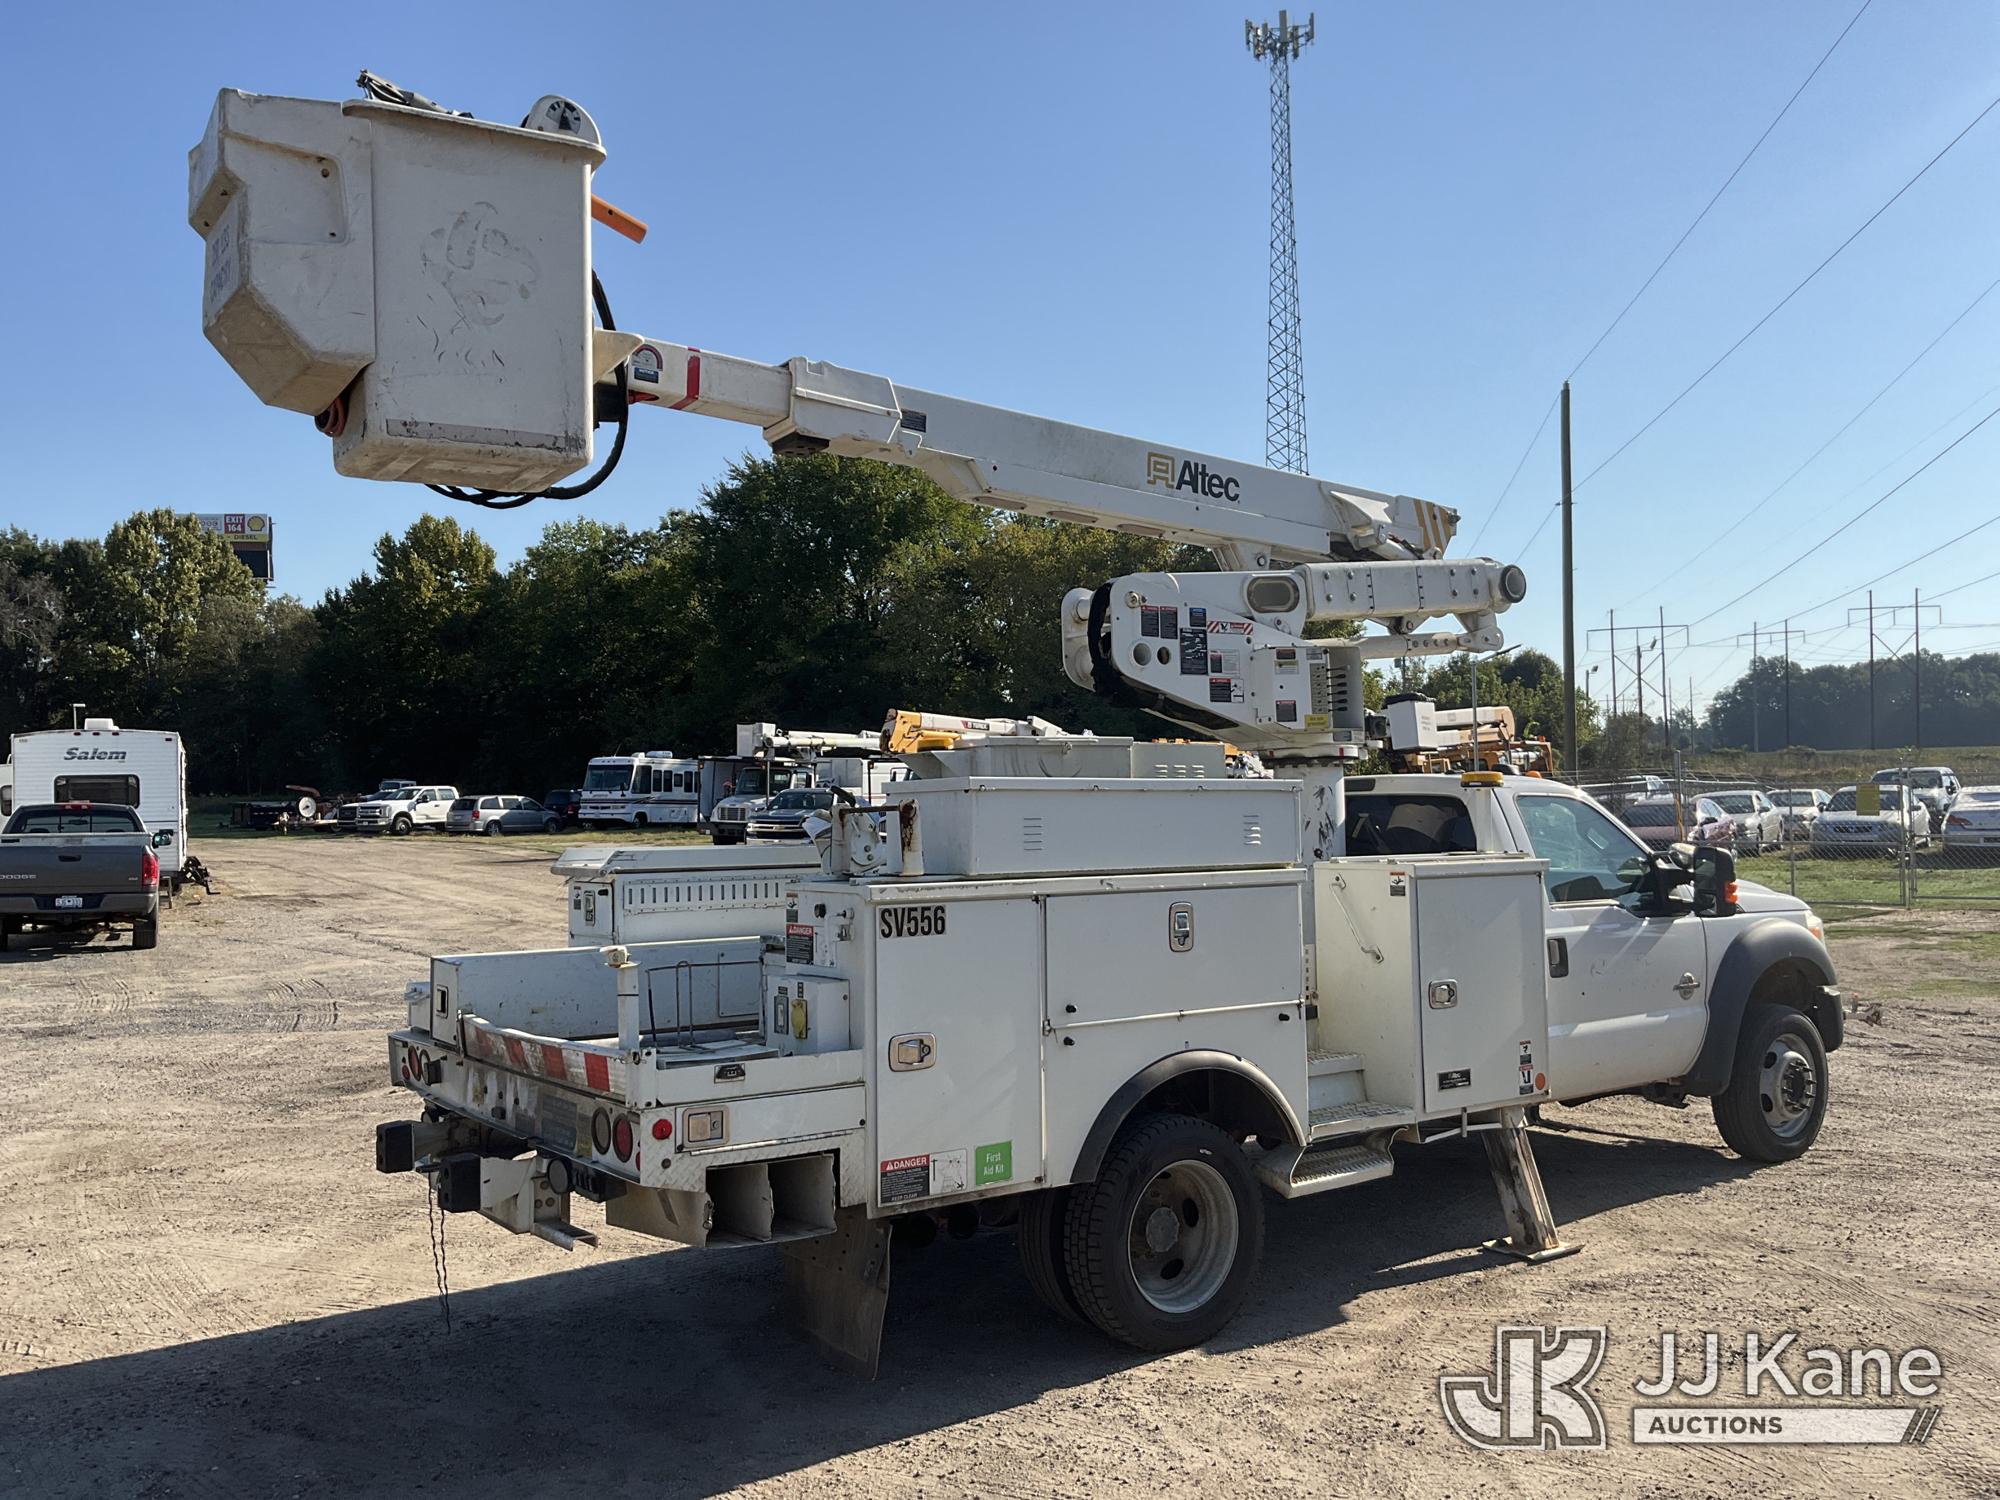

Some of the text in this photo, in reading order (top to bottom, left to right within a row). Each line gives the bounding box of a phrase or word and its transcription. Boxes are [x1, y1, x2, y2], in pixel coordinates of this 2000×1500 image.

[1176, 459, 1240, 503] Altec
[226, 515, 243, 523] EXIT
[227, 524, 241, 532] 164
[64, 747, 127, 761] Salem
[880, 905, 946, 939] SV556
[986, 1152, 1001, 1162] First
[893, 1157, 927, 1170] DANGER
[983, 1164, 1004, 1176] Aid Kit
